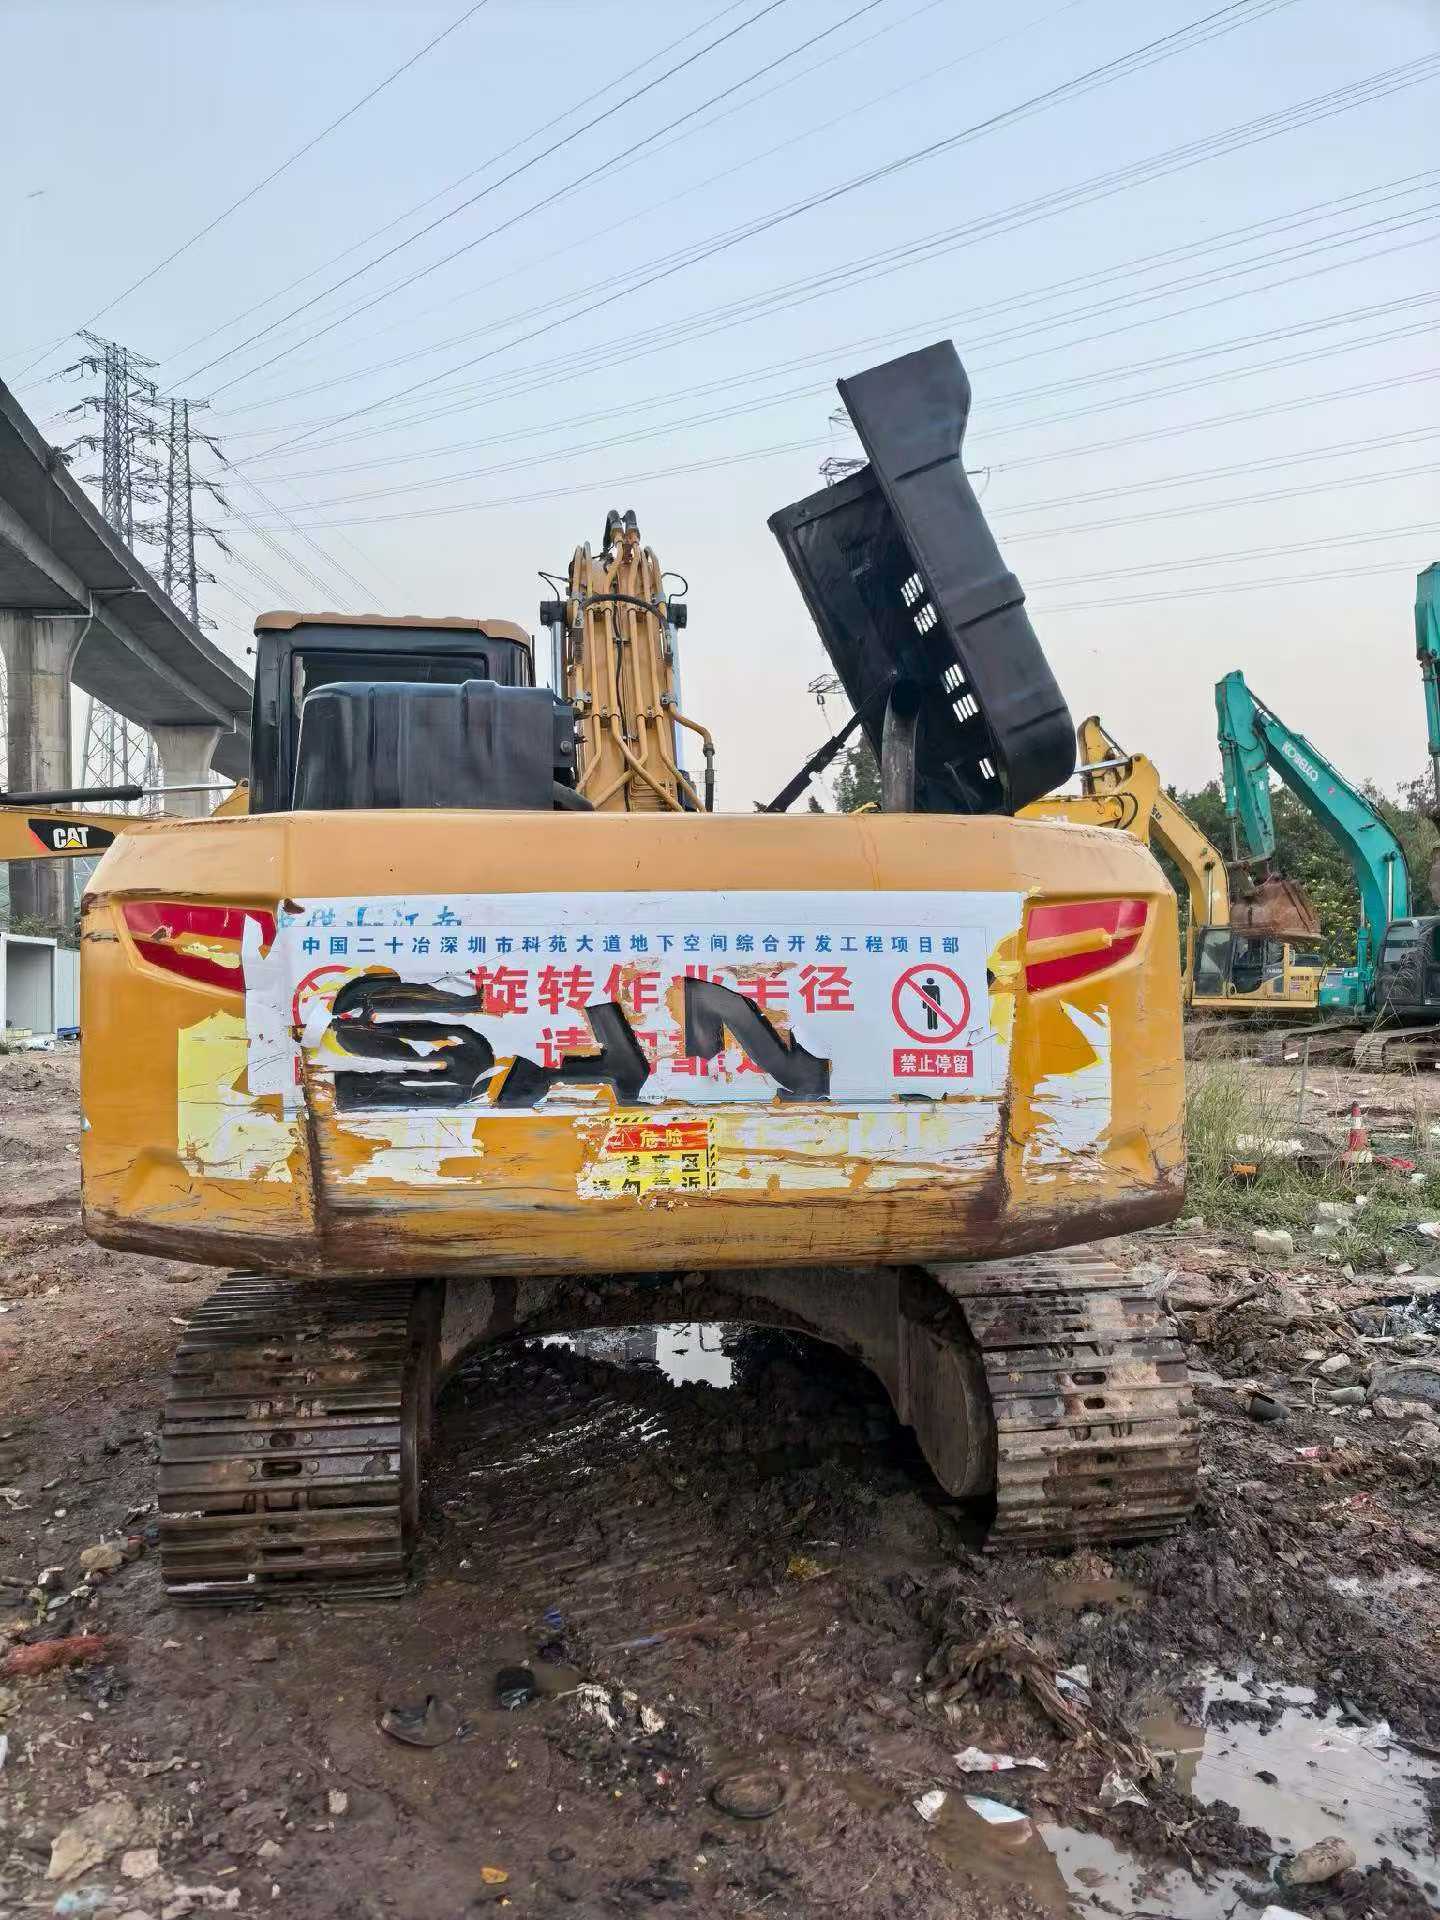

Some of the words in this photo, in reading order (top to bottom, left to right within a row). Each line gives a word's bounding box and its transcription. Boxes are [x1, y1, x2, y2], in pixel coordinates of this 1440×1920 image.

[53, 827, 89, 848] CAT
[302, 935, 960, 955] 中国二十冶深圳市科苑大道地下空间综合开发工程项目部
[900, 1053, 968, 1074] 禁止停留
